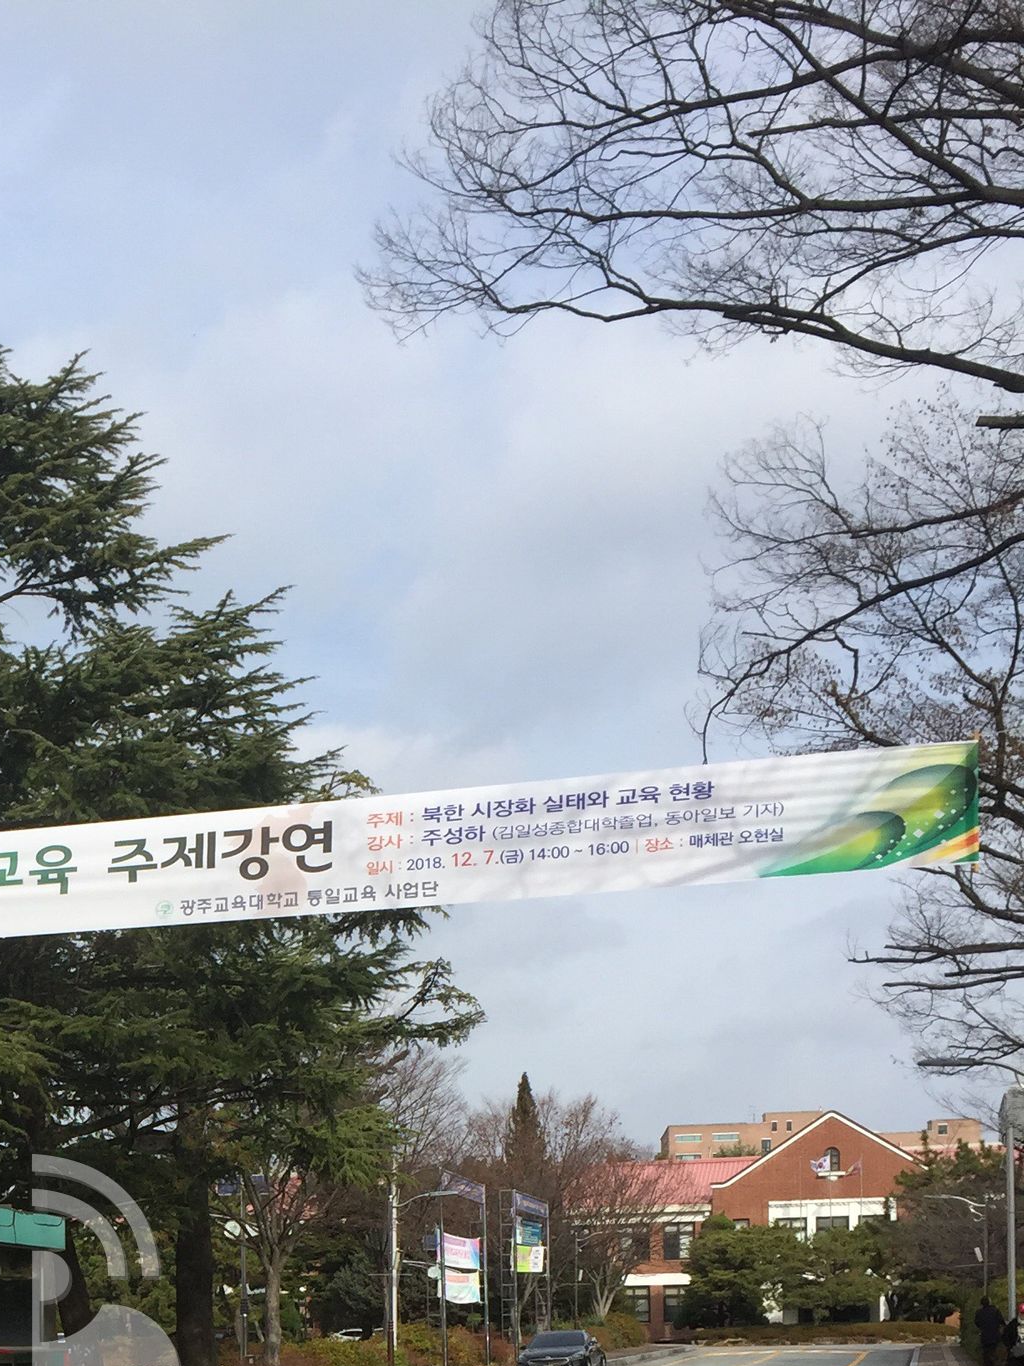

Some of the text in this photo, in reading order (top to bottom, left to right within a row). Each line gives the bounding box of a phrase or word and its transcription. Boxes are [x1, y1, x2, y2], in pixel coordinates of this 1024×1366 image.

[367, 811, 403, 828] 주제
[422, 803, 465, 823] 북한
[471, 797, 536, 818] 시장화
[543, 790, 609, 813] 실태와
[616, 785, 661, 804] 교육
[669, 781, 715, 801] 현황
[367, 834, 403, 851] 강사
[421, 825, 485, 846] 주성하
[665, 806, 736, 826] 동아일보
[743, 802, 785, 818] 기자)
[107, 820, 333, 883] 주제강연
[367, 860, 393, 876] 일시
[407, 857, 446, 871] 2018.
[452, 852, 476, 867] 12.
[529, 846, 570, 861] 14:00
[588, 841, 629, 856] 16:00
[645, 837, 674, 853] 장소
[689, 832, 734, 848] 매체관
[180, 880, 439, 916] 광주교육대학교 통일교육 사업단
